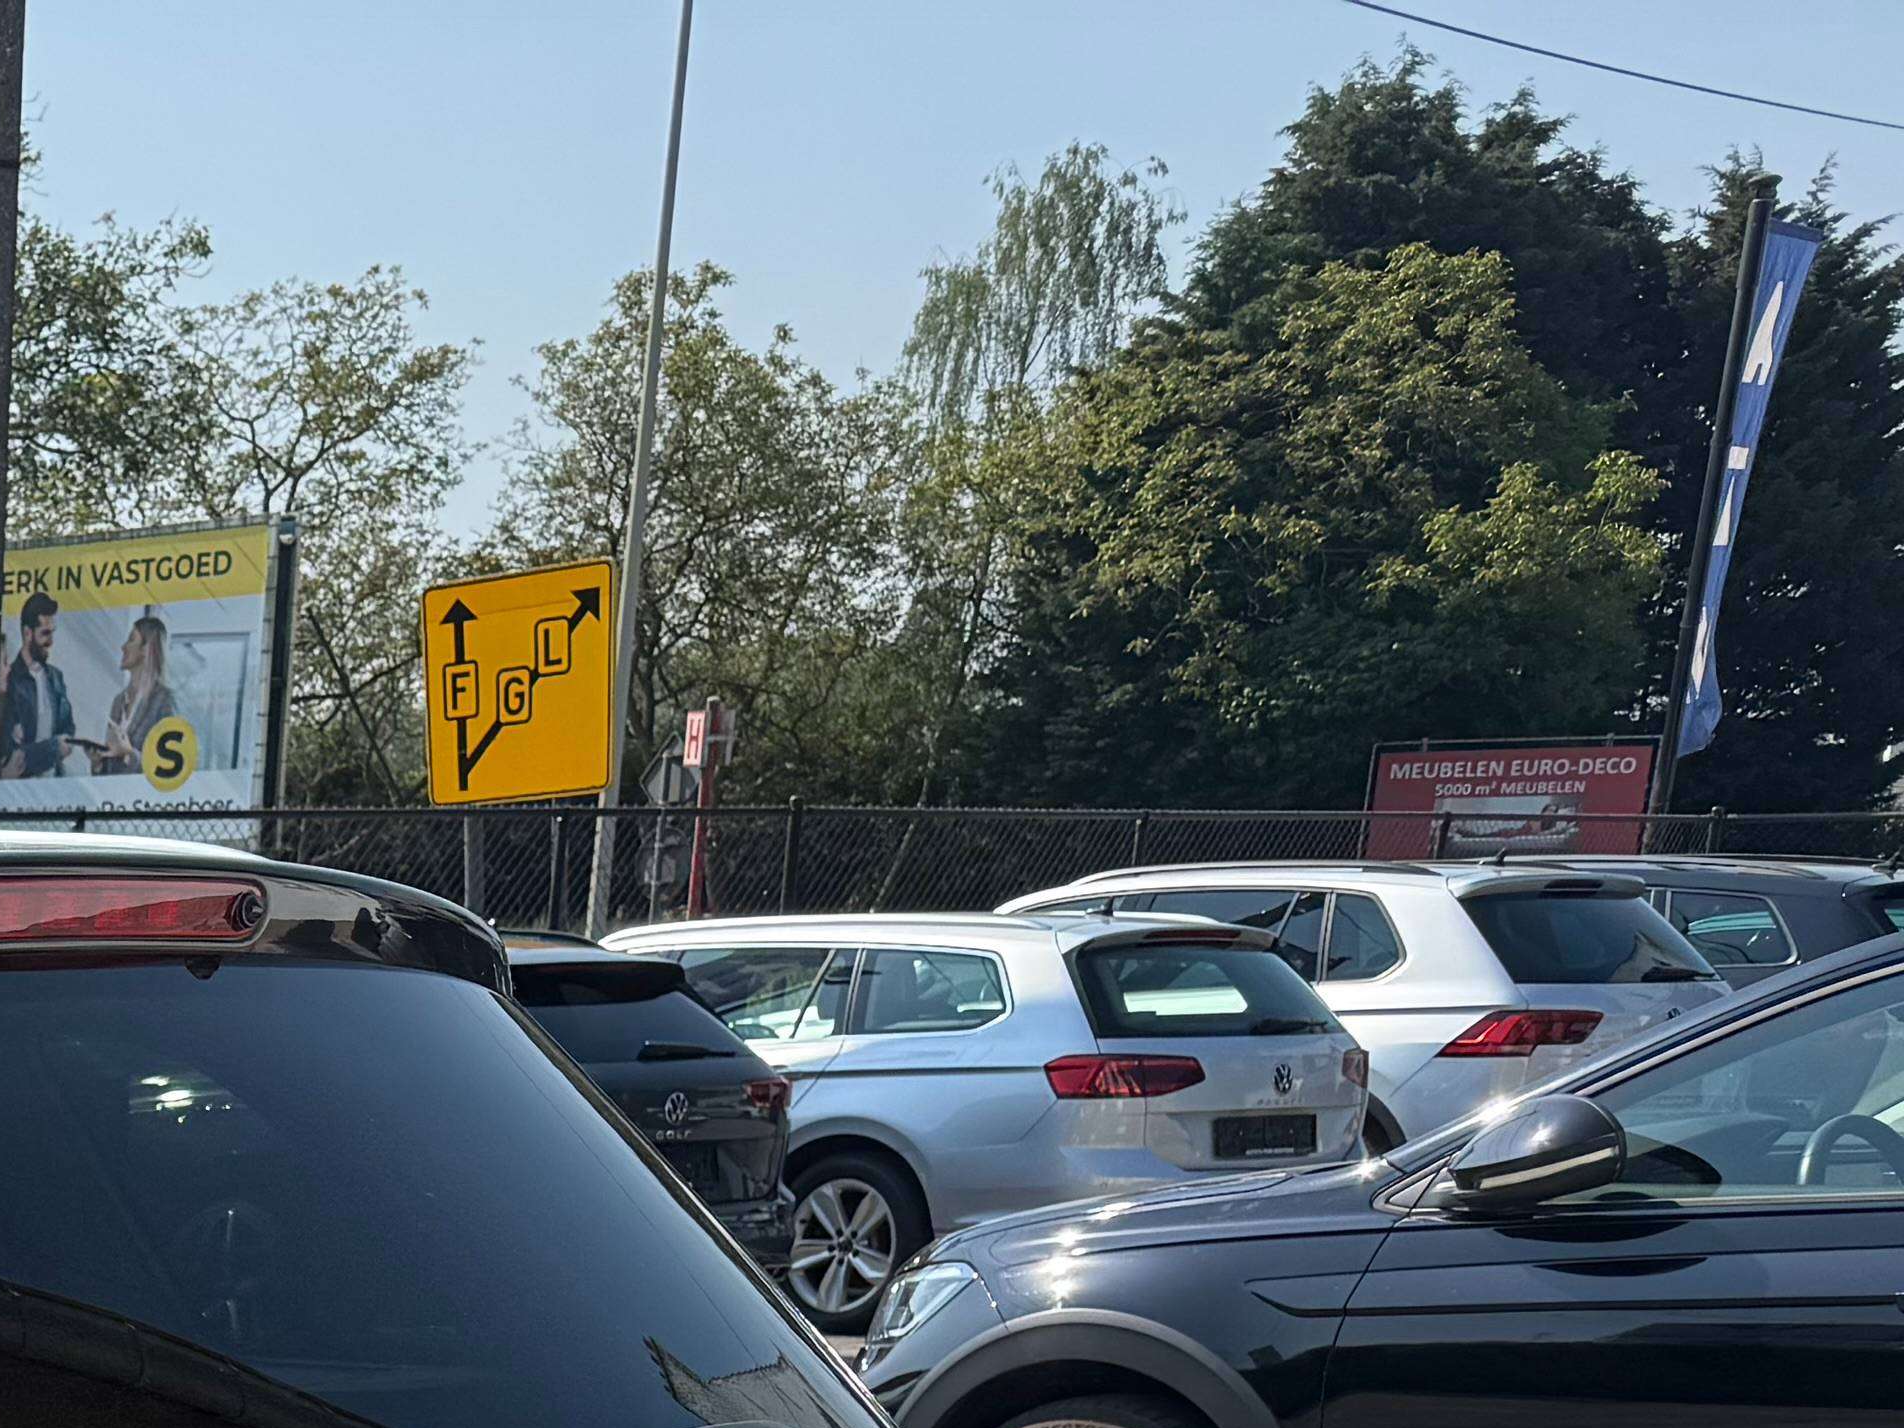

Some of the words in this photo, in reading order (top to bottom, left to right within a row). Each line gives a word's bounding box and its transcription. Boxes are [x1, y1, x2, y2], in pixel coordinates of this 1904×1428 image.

[2, 567, 50, 594] ERK
[57, 565, 82, 591] IN
[92, 550, 232, 588] VASTGOED
[543, 628, 563, 667] L
[451, 671, 471, 710] F
[503, 677, 526, 716] G
[1390, 761, 1504, 780] MEUBELEN
[1510, 757, 1637, 777] EURO-DECO
[1435, 782, 1472, 796] 5000
[1500, 780, 1586, 795] MEUBELEN
